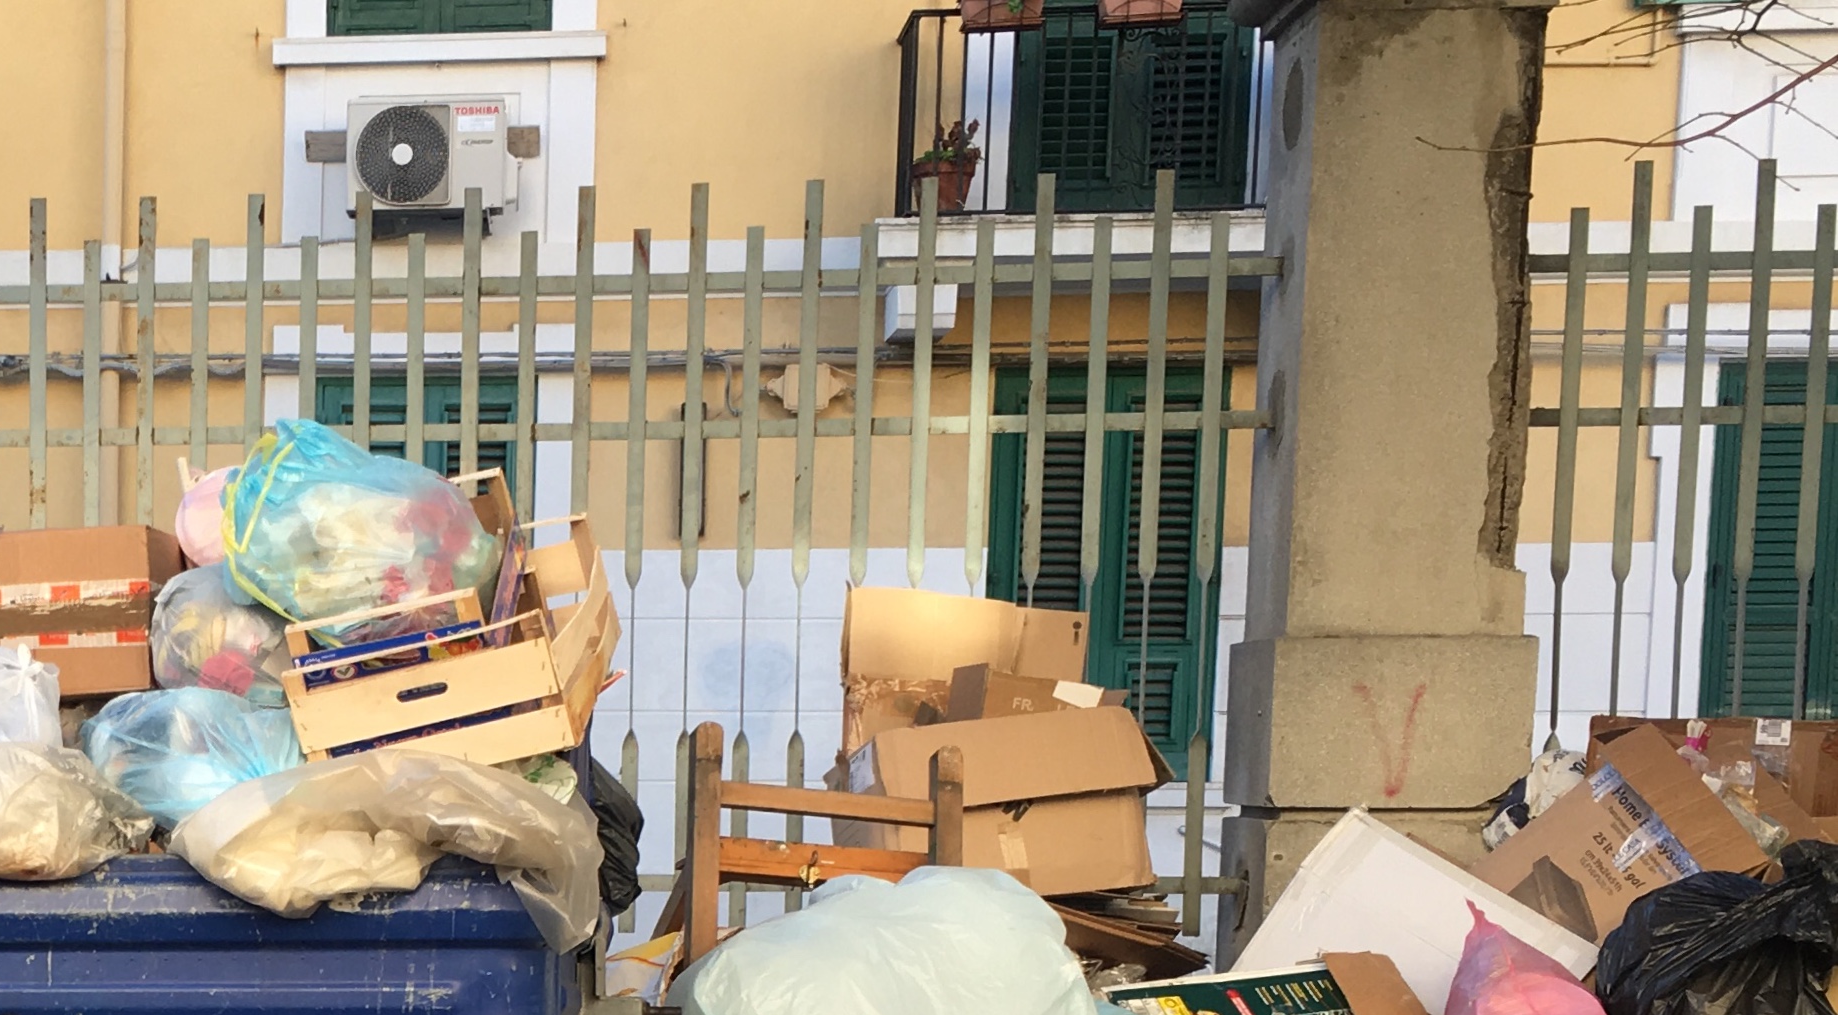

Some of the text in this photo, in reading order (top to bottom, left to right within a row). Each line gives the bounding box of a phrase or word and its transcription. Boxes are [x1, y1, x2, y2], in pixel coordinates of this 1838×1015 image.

[454, 106, 500, 115] TOSHIBA
[1611, 786, 1642, 821] Home
[1593, 832, 1604, 846] 25
[1624, 871, 1646, 890] gal
